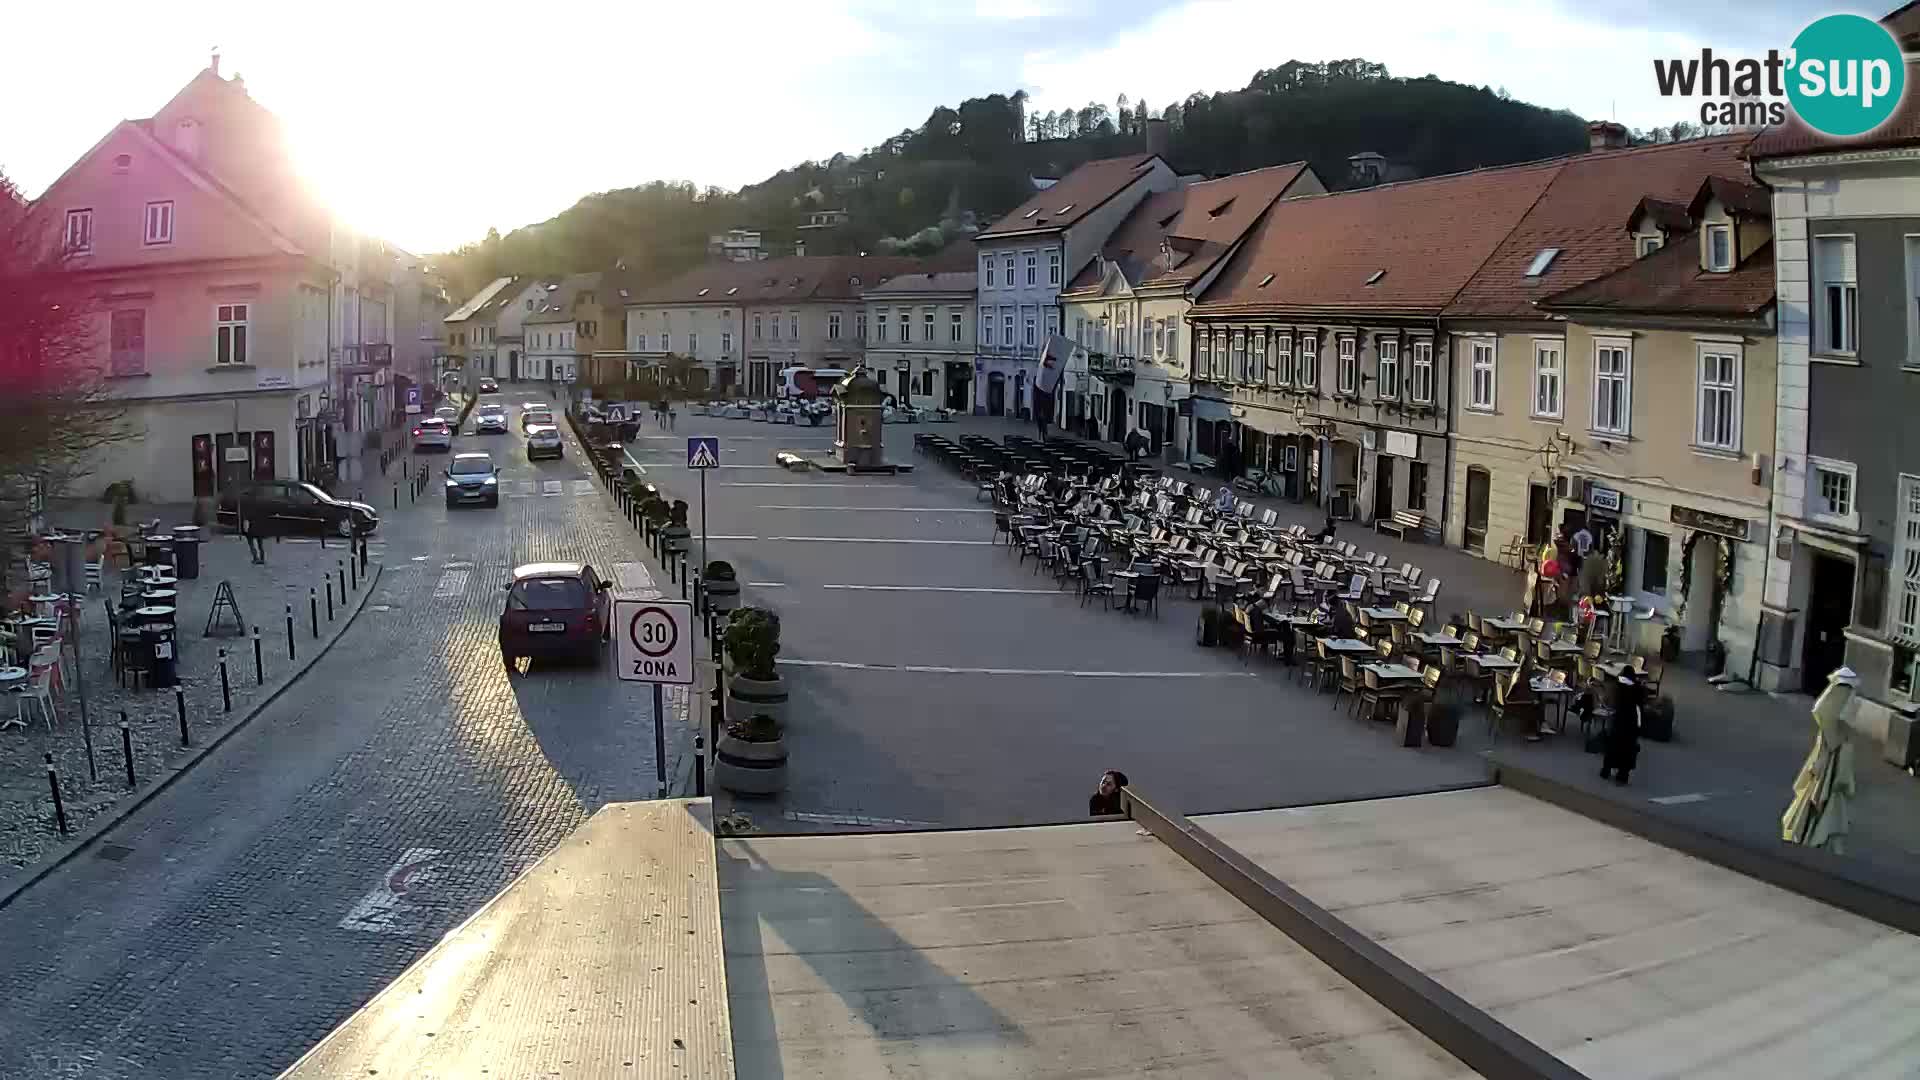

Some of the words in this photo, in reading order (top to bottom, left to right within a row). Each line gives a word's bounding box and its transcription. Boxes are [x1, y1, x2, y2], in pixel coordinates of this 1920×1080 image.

[409, 391, 417, 403] P
[642, 622, 667, 644] 30
[633, 659, 677, 677] ZONA
